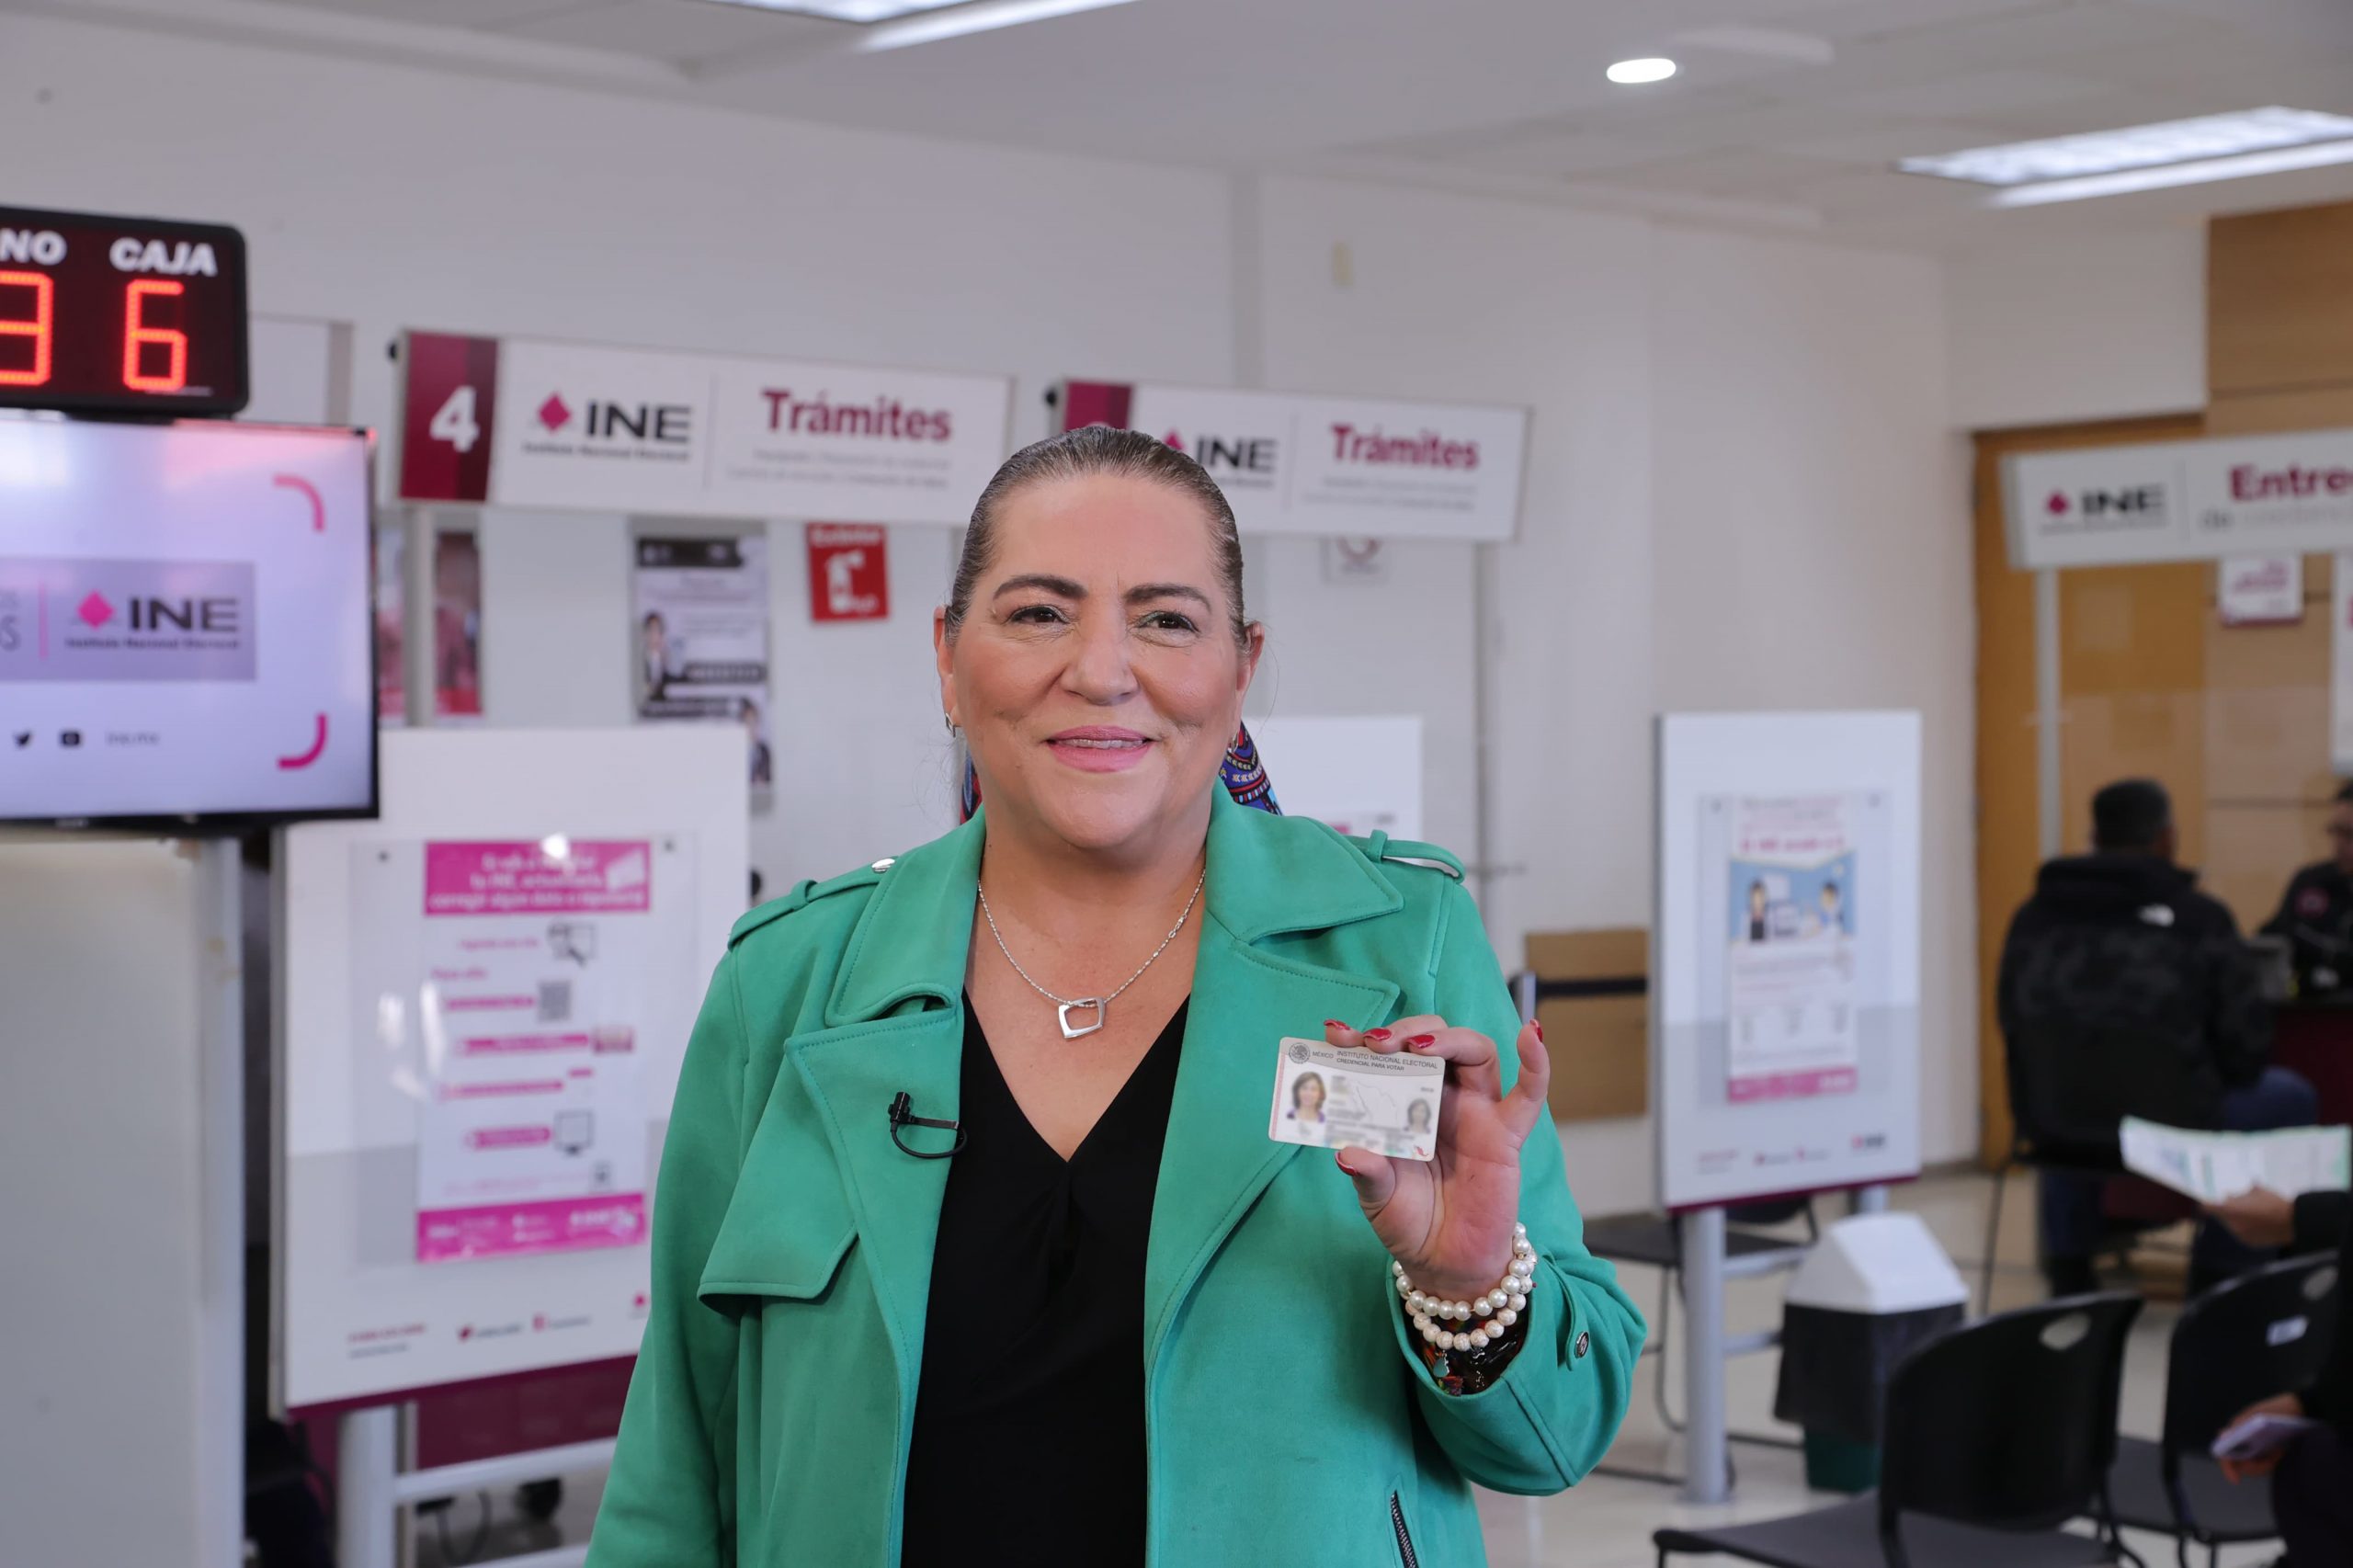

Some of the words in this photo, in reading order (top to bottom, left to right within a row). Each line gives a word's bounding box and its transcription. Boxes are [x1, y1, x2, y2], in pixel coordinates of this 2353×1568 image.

[108, 236, 218, 277] CAJA
[123, 278, 188, 392] 6
[429, 385, 480, 453] 4
[585, 399, 692, 443] INE
[761, 386, 952, 443] Trámites
[1197, 435, 1279, 473] INE
[1331, 422, 1479, 472] Trámites
[2081, 483, 2165, 515] INE
[128, 597, 239, 632] INE
[1336, 1050, 1369, 1061] INSTITUTO
[1370, 1054, 1401, 1064] NACIONAL
[1402, 1059, 1438, 1070] ELECTORAL
[1336, 1057, 1370, 1066] CREDENCIAL
[1370, 1062, 1385, 1070] PARA
[1386, 1063, 1404, 1072] VOTAR
